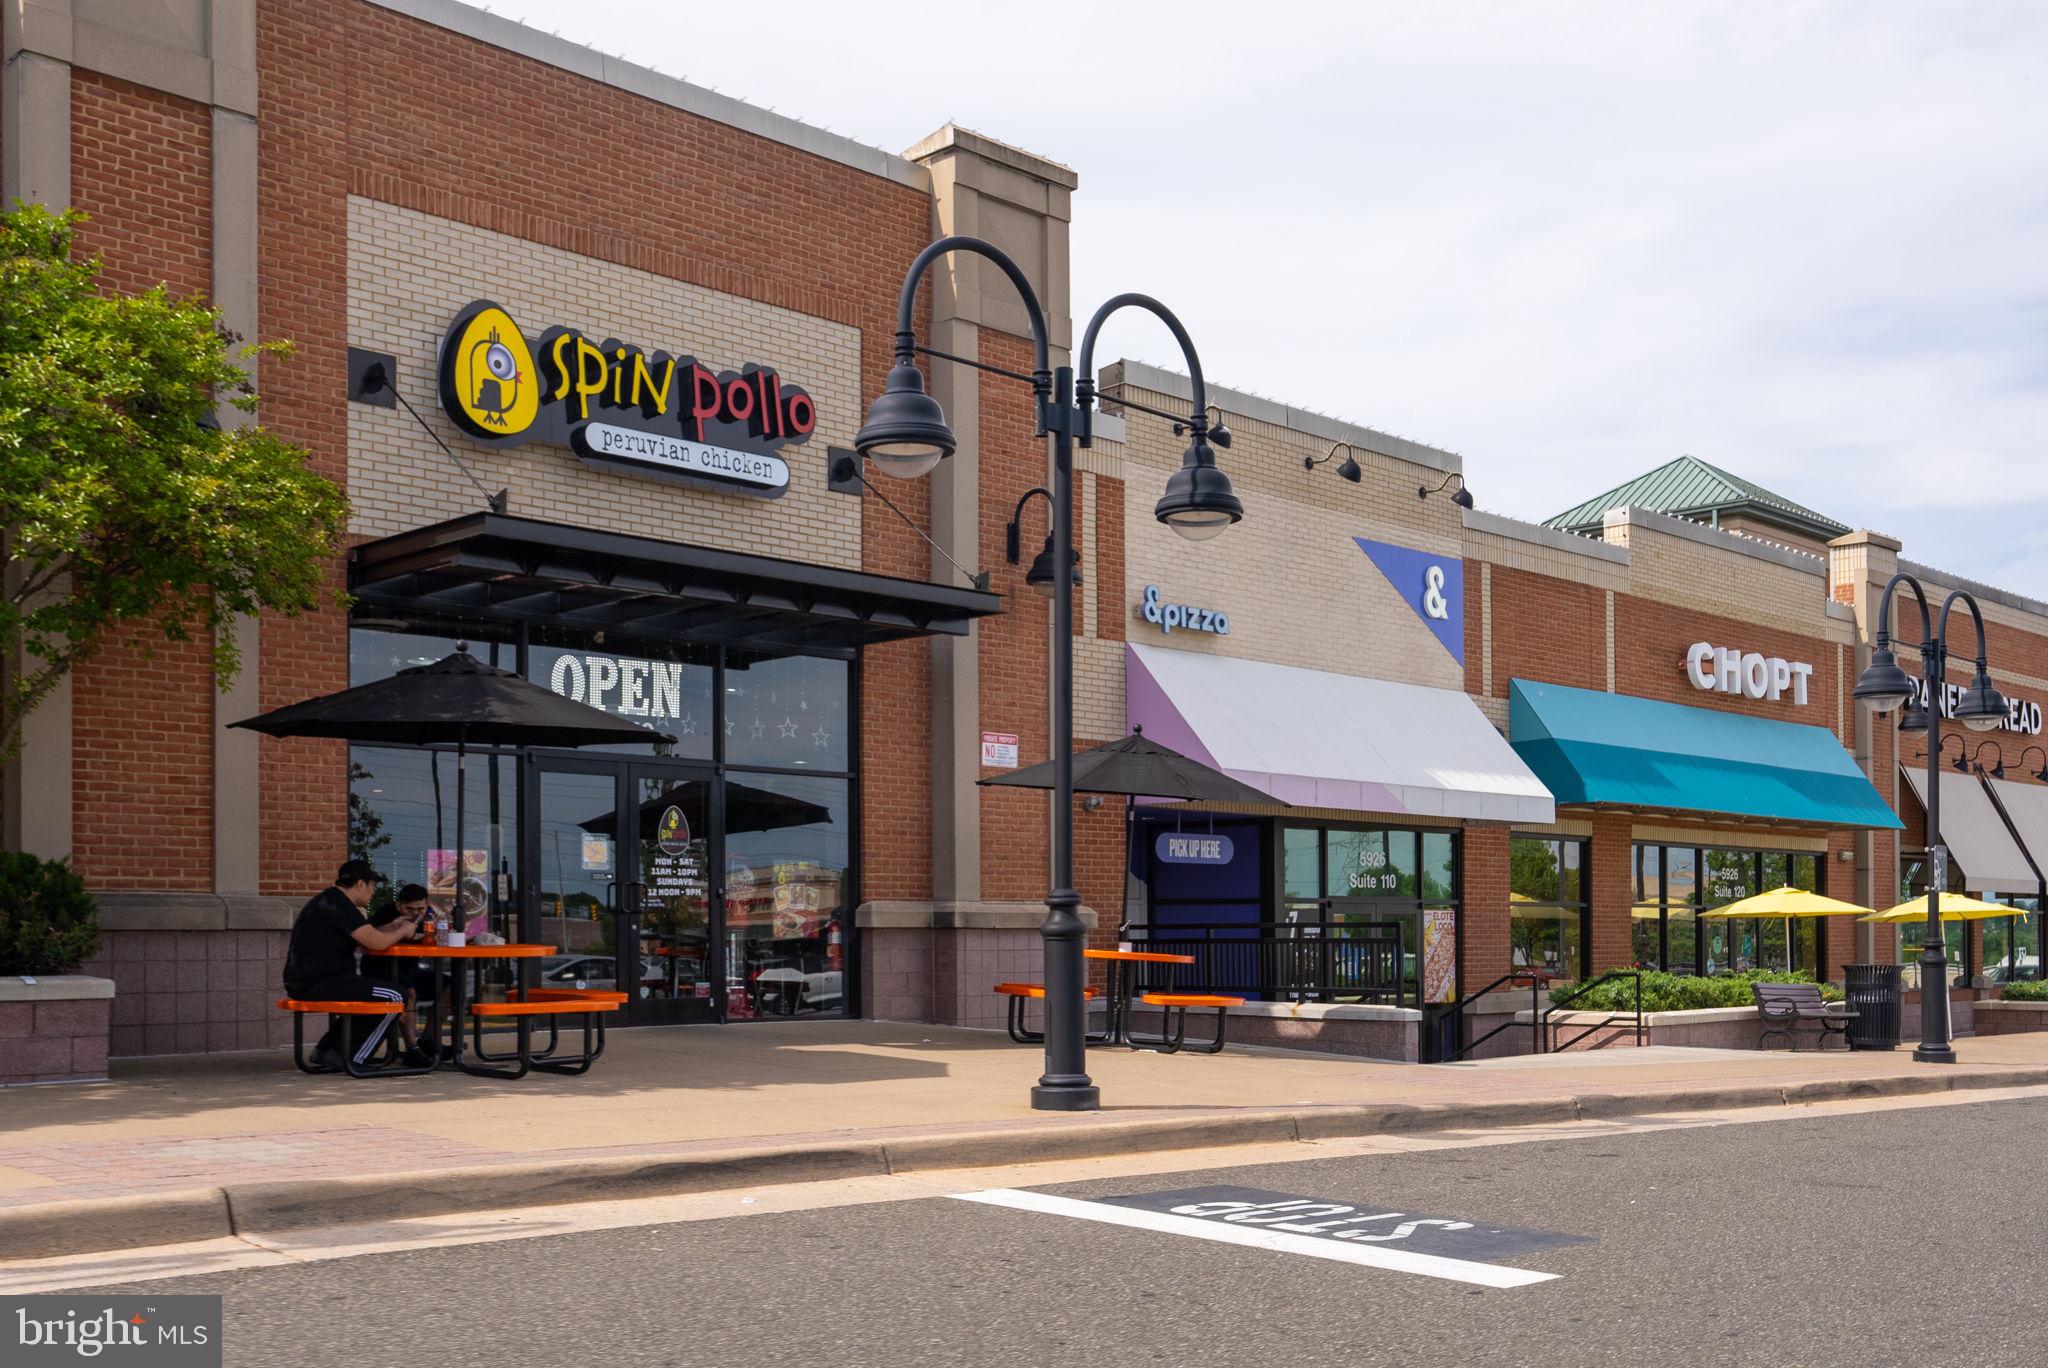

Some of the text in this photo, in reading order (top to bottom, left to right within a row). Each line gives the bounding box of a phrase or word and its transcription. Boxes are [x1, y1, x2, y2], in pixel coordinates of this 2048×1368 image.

[691, 361, 816, 442] pollo
[602, 429, 773, 479] peruvian chicken
[1423, 565, 1449, 620] &
[1142, 584, 1229, 634] &pizza
[551, 654, 683, 718] OPEN
[1687, 642, 1813, 705] CHOPT
[2000, 697, 2042, 736] READ
[655, 858, 672, 866] MON
[679, 858, 694, 866] SAT
[1169, 839, 1220, 859] PICK UP HERE
[1360, 852, 1386, 866] 5926
[656, 878, 693, 886] SUNDAYS
[1350, 873, 1396, 888] Suite 110
[1722, 869, 1738, 880] 5926
[1715, 885, 1745, 898] Suite 120
[1433, 912, 1454, 920] ELOTE
[1170, 1200, 1474, 1241] STOP
